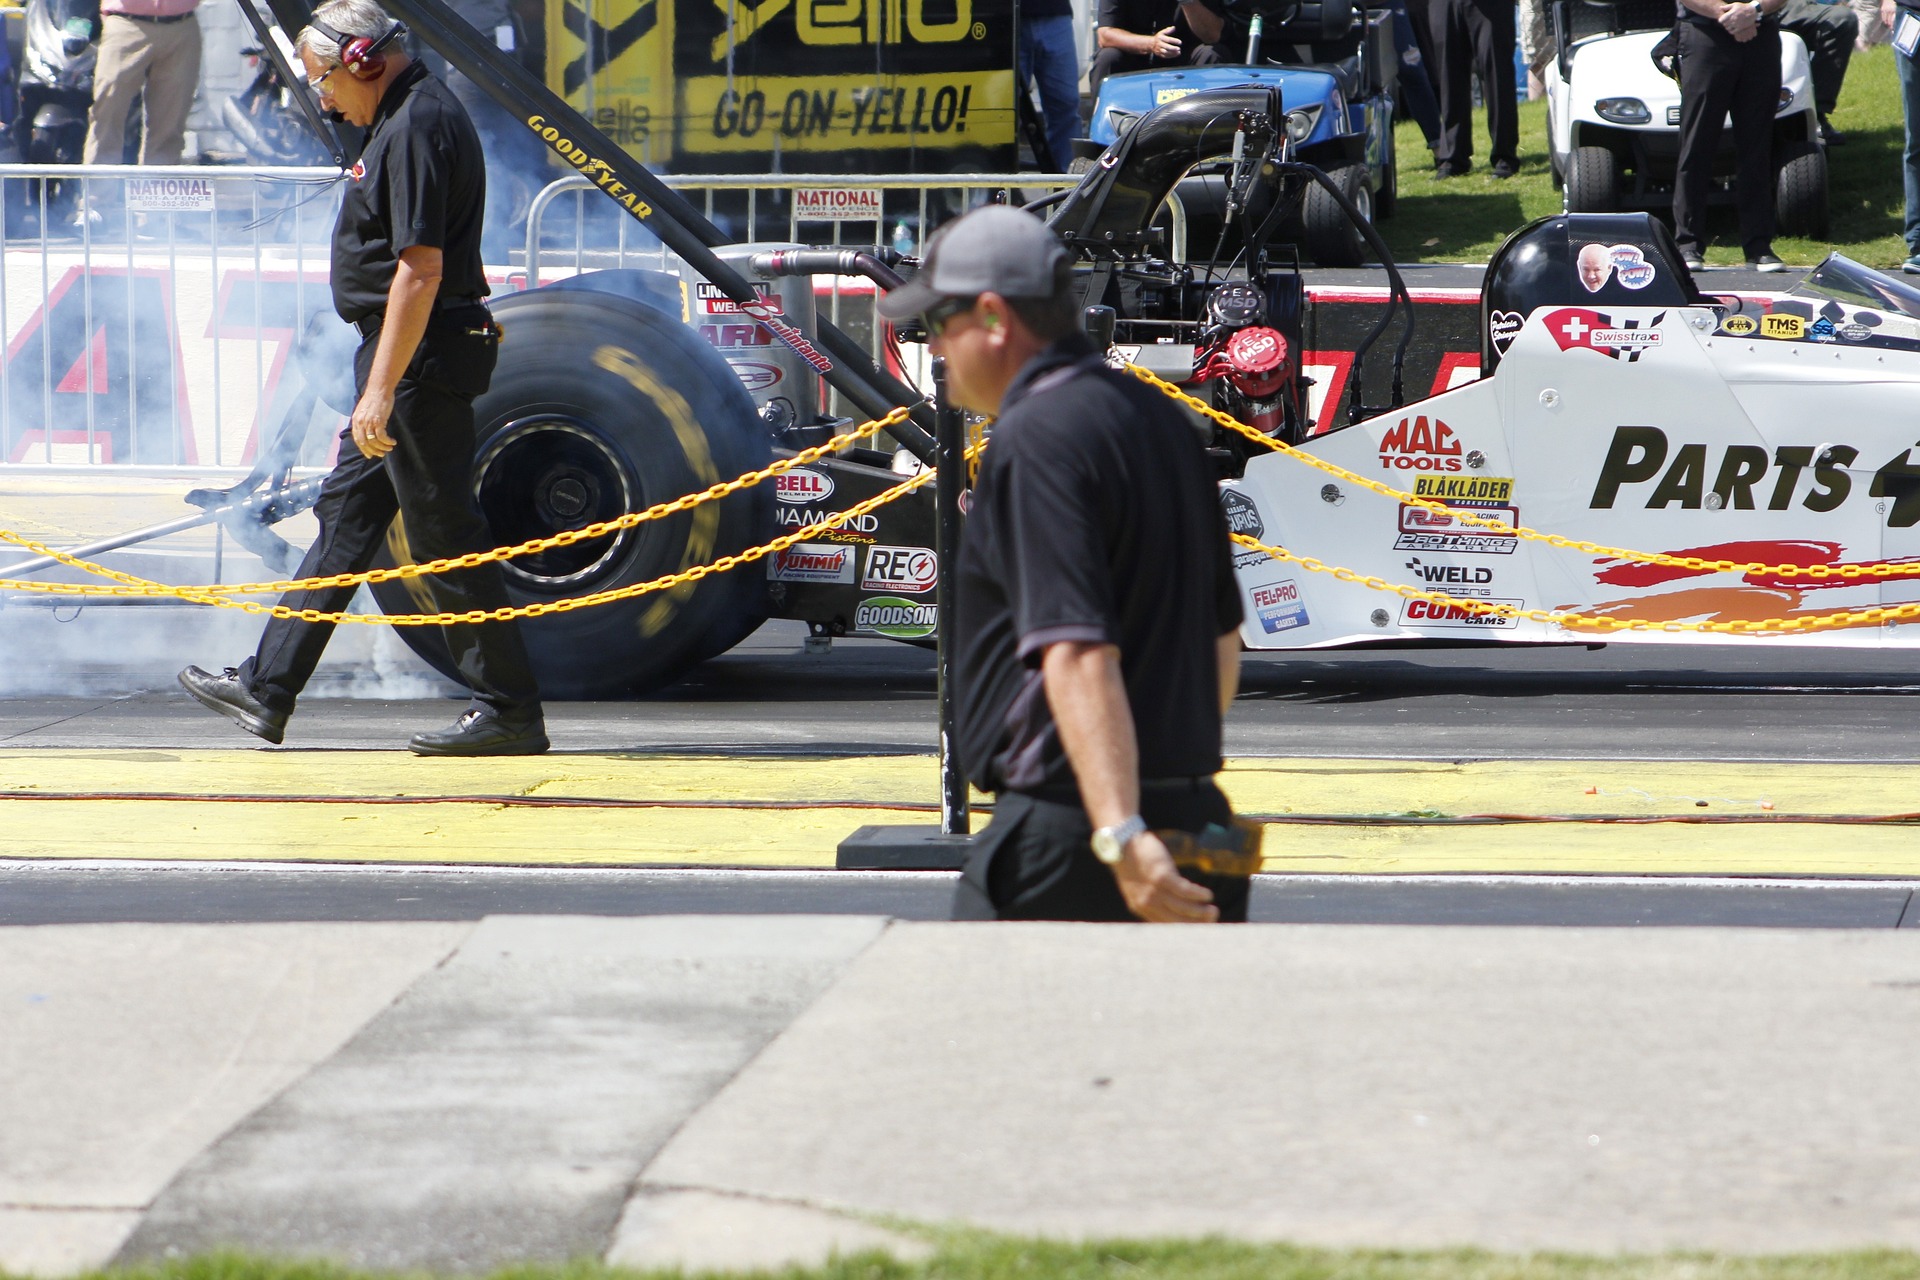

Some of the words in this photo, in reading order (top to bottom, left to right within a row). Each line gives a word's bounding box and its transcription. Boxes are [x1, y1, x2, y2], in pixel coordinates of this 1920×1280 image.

[713, 84, 972, 138] GO-ON-YELLO!
[129, 179, 212, 196] NATIONAL
[797, 190, 879, 206] NATIONAL
[1218, 297, 1258, 308] MSD
[1767, 318, 1799, 331] TMS
[1595, 331, 1654, 342] Swisstrax
[1240, 336, 1275, 361] MSD
[1379, 415, 1462, 456] MAC
[1379, 455, 1462, 472] TOOLS
[1589, 425, 1859, 512] PARTS
[1416, 475, 1510, 499] BLÅKLÄDER
[817, 530, 877, 544] Pistons
[1406, 544, 1503, 552] APPAREL
[1423, 565, 1493, 584] WELD
[885, 583, 921, 591] ELECTRONICS
[1426, 586, 1491, 596] RACING
[857, 606, 938, 625] GOODSON
[1464, 617, 1507, 625] CAMS
